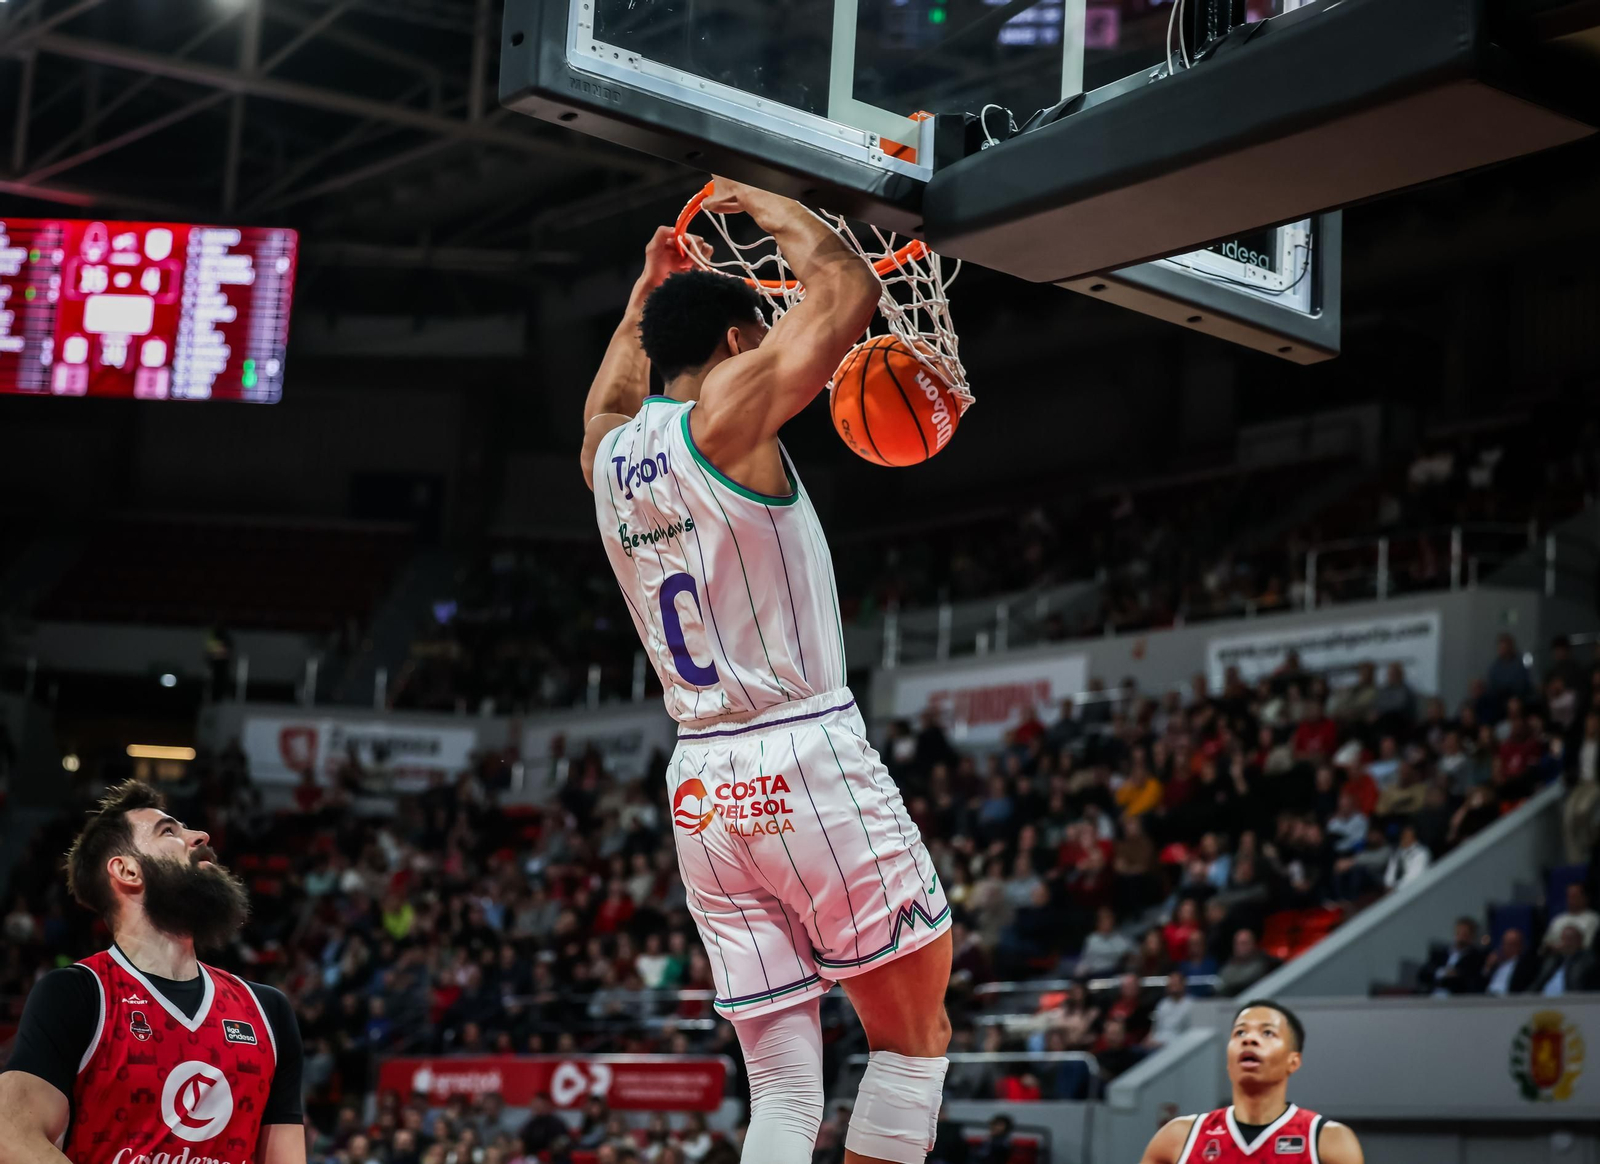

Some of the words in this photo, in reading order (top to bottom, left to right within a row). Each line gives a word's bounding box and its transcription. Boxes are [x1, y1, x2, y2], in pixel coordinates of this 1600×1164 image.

[1207, 240, 1270, 270] desa
[915, 369, 953, 450] Wilson
[611, 452, 669, 500] Tyson
[659, 572, 720, 687] 0
[715, 774, 791, 801] COSTA
[724, 818, 796, 837] ÁLAGA
[228, 1033, 255, 1042] endesa
